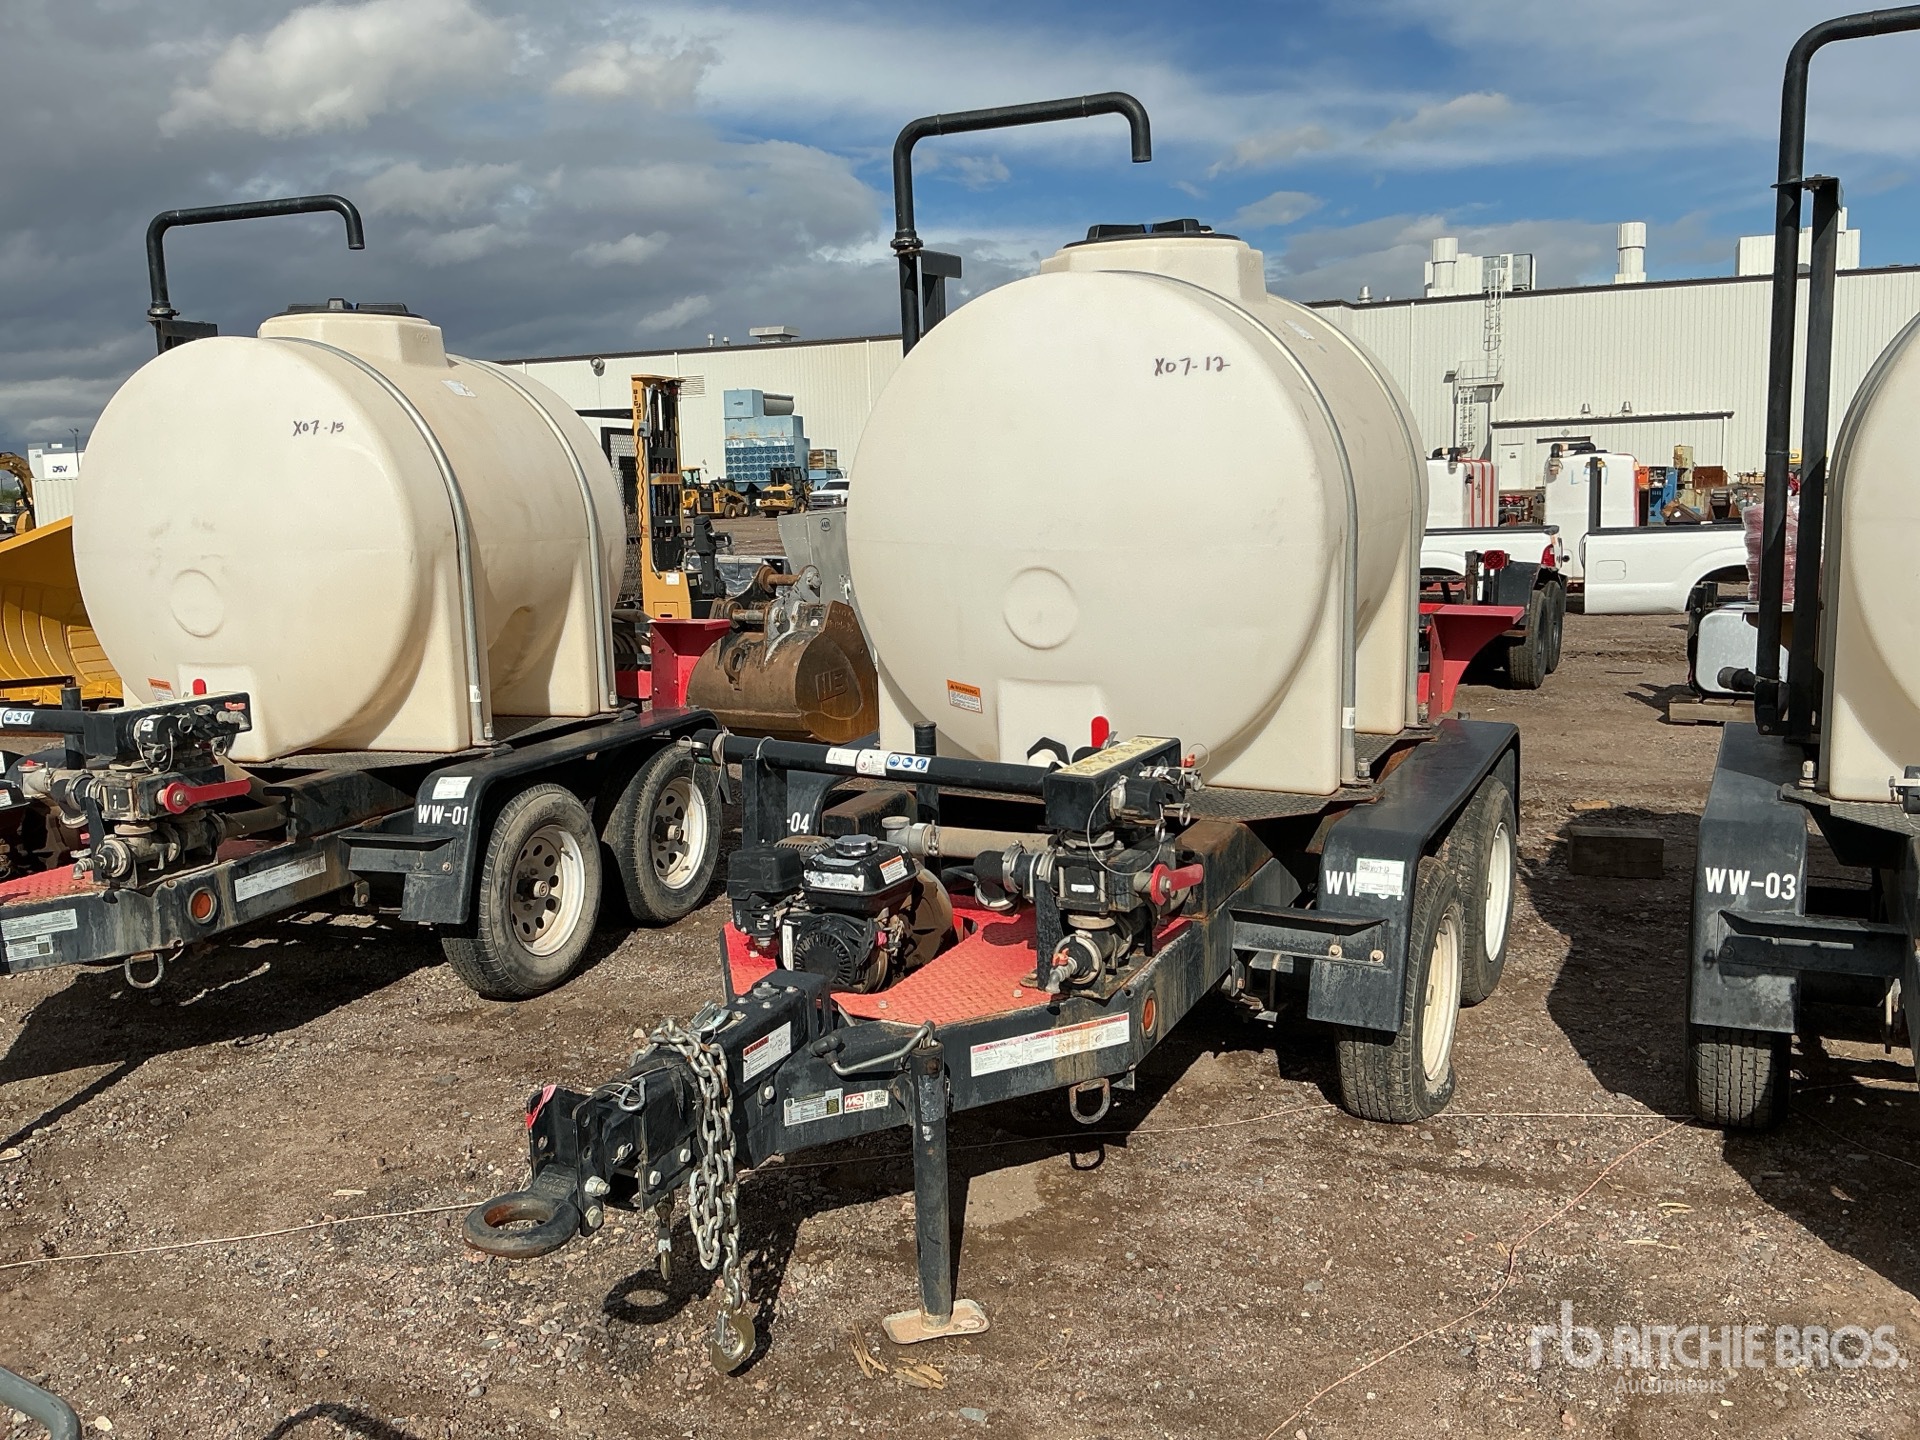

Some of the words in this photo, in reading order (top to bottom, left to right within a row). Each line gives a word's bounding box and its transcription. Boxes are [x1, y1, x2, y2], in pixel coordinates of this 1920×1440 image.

[1154, 356, 1231, 376] X07-12
[52, 465, 68, 473] DSV
[418, 804, 469, 826] WW-01
[1705, 867, 1796, 901] WW-03
